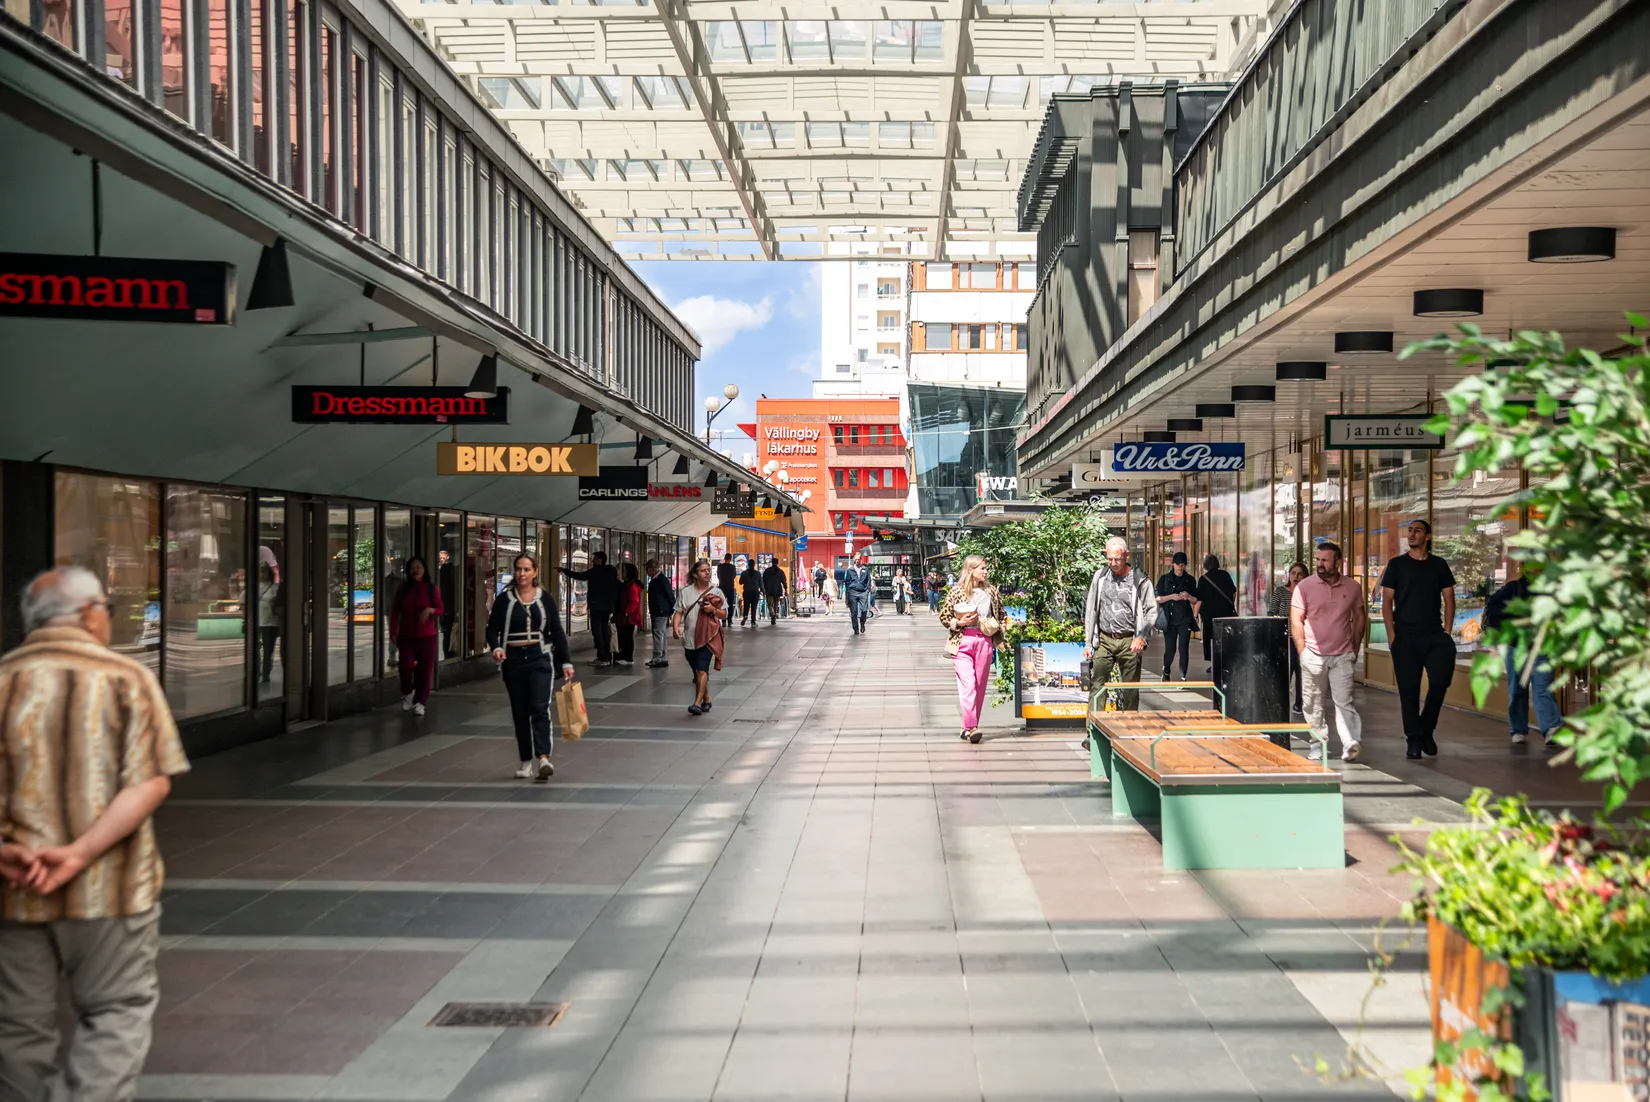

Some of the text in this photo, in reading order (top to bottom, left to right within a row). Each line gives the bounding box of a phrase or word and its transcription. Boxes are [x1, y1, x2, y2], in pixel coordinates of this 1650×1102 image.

[311, 391, 488, 415] Dressmann
[764, 426, 820, 440] Vällingby
[1345, 423, 1425, 440] jarméus
[767, 442, 817, 454] läkarhus
[1115, 444, 1244, 470] Ur&Penn
[580, 488, 648, 497] CARLINGS
